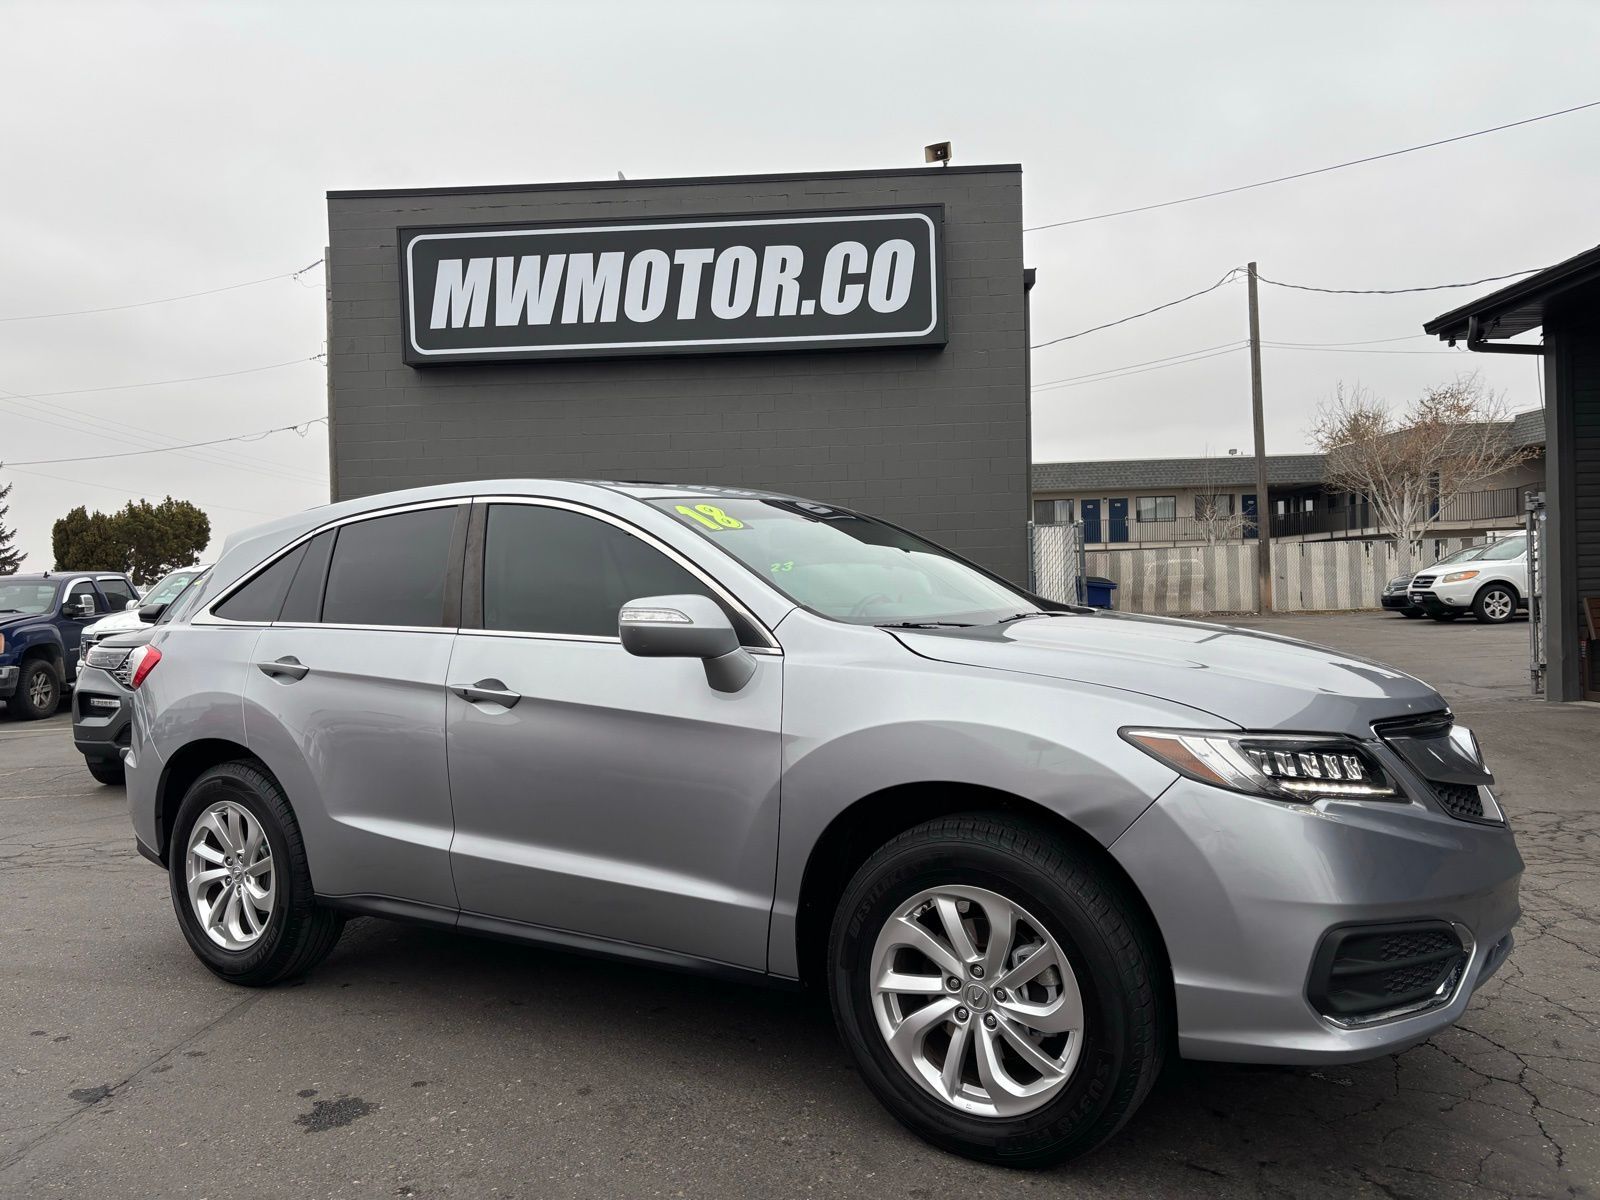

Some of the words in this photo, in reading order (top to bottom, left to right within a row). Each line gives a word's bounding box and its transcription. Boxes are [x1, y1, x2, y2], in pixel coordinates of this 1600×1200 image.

[429, 238, 915, 330] MWMOTOR.CO
[675, 504, 744, 530] 18
[770, 560, 794, 572] 23
